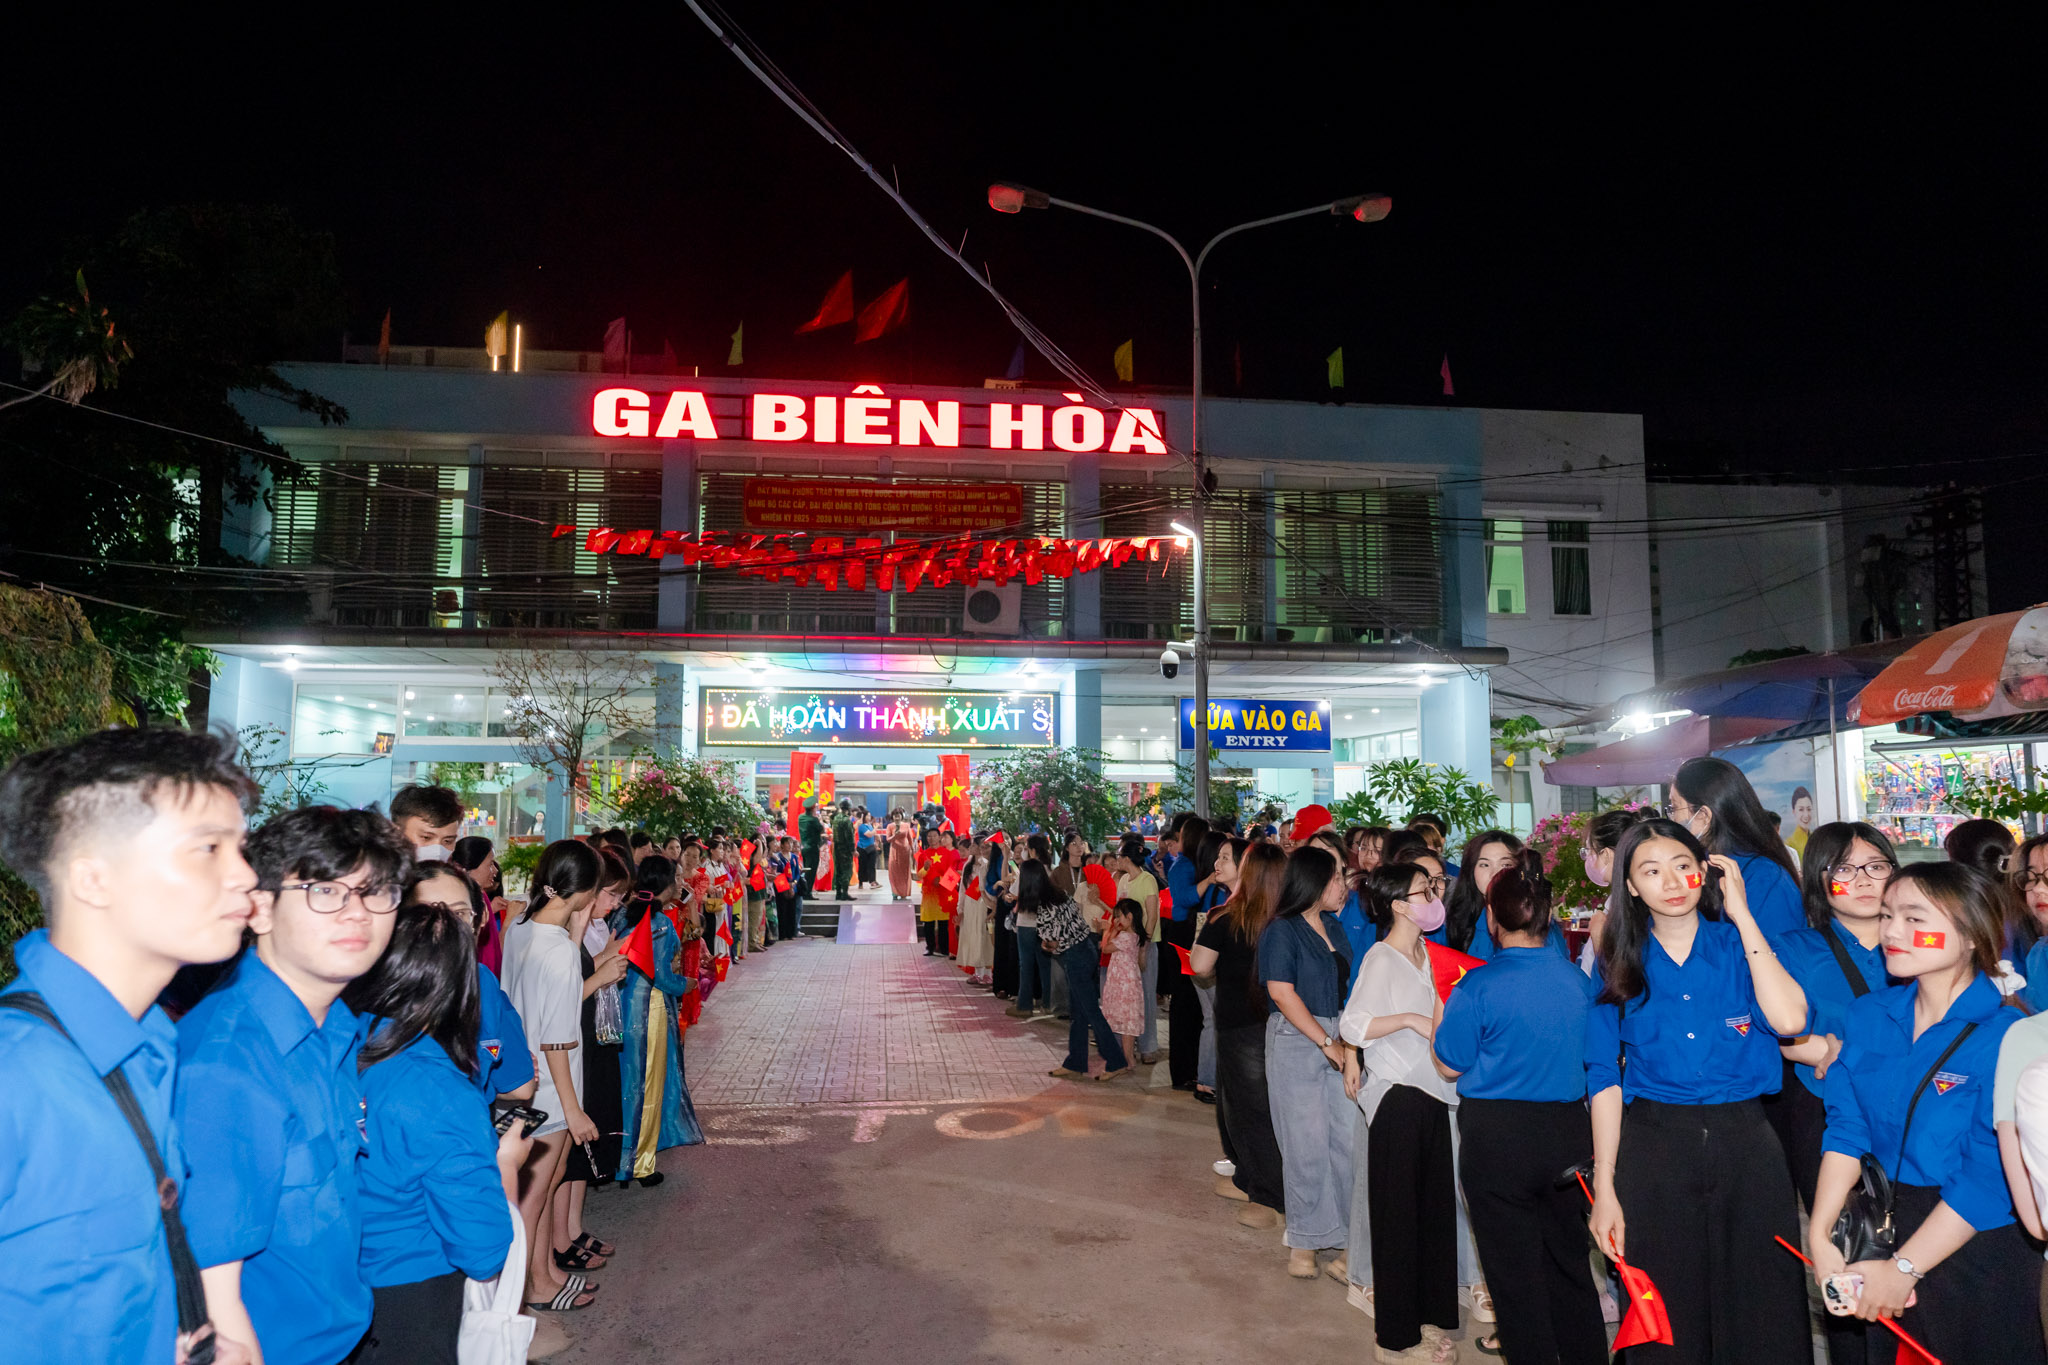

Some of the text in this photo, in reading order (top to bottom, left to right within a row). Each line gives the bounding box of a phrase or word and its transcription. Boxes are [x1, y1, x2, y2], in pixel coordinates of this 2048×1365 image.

[592, 384, 1168, 455] GA BIÊN HÒA
[1894, 685, 1958, 711] Coca-Cola
[1242, 705, 1286, 731] VÀO
[1292, 711, 1322, 731] GA
[1225, 735, 1288, 747] ENTRY
